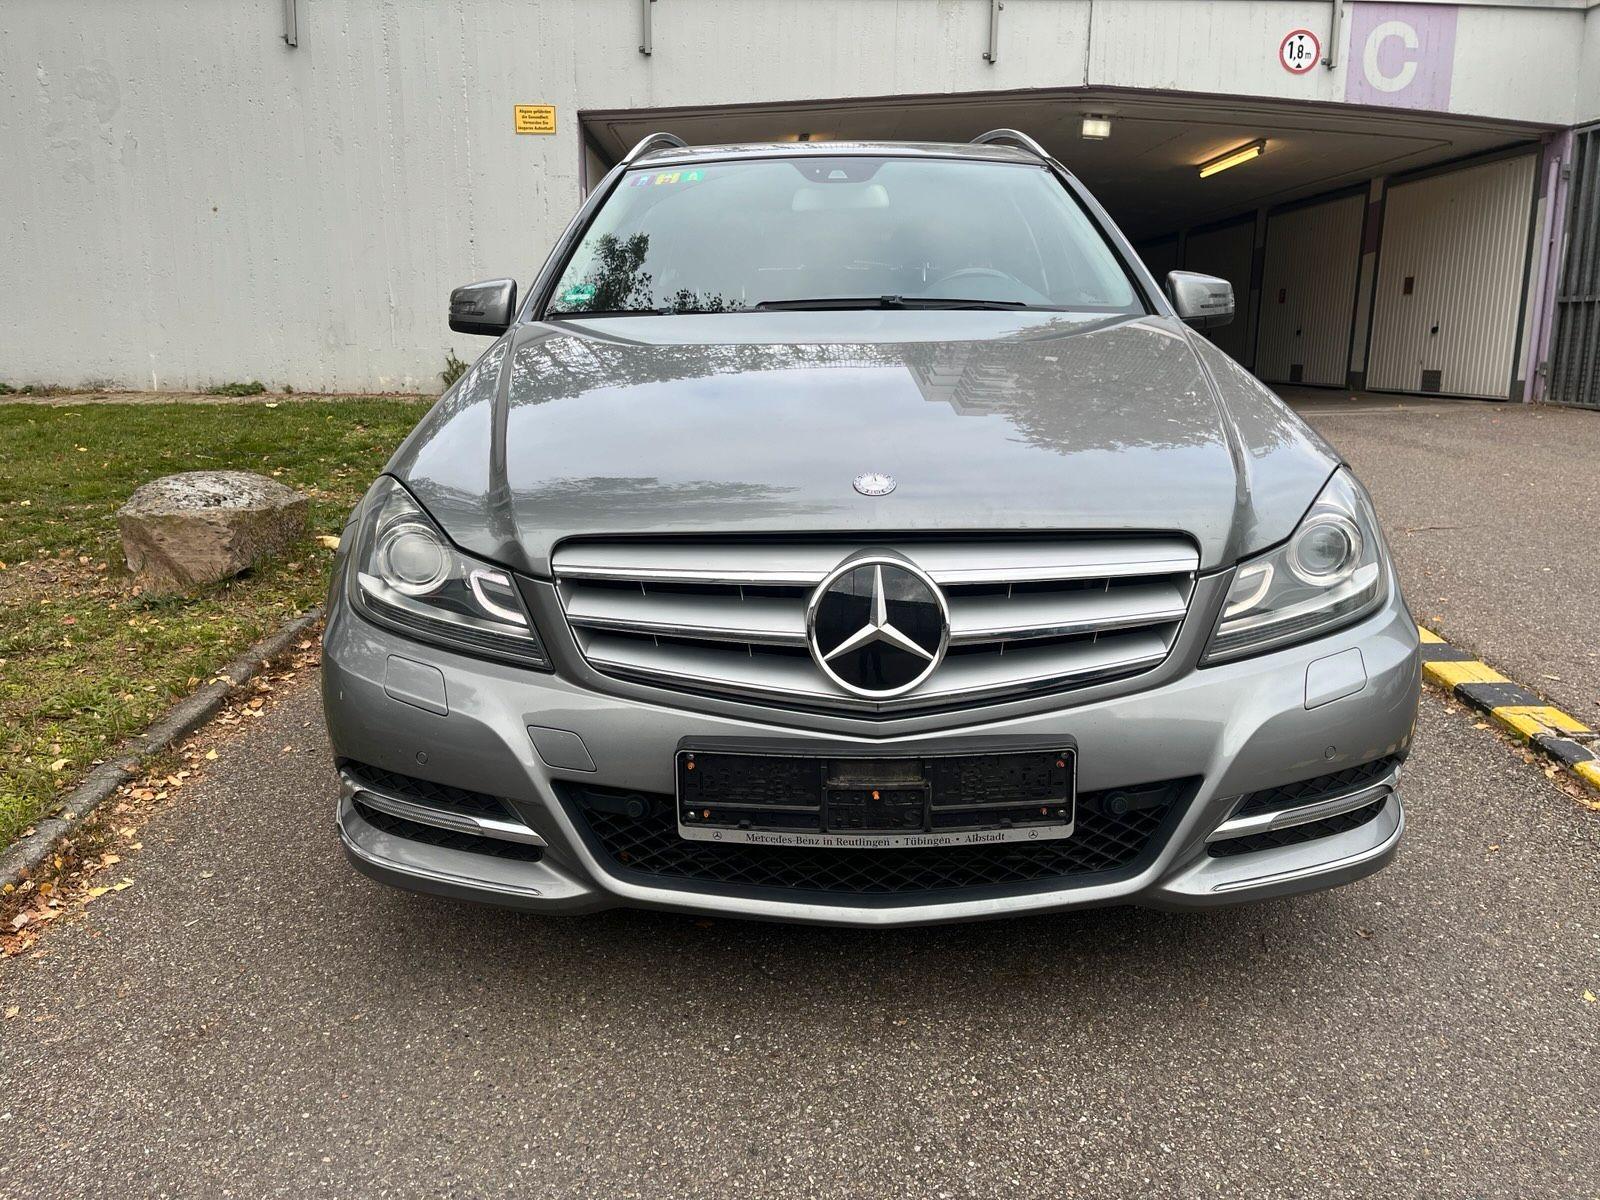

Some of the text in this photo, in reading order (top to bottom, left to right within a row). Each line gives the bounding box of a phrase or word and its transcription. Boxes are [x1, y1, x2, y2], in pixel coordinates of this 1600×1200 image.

[1363, 20, 1418, 92] C
[746, 833, 1004, 848] Mercedes-Benz in Reutlingen Tübingen Albstadt
